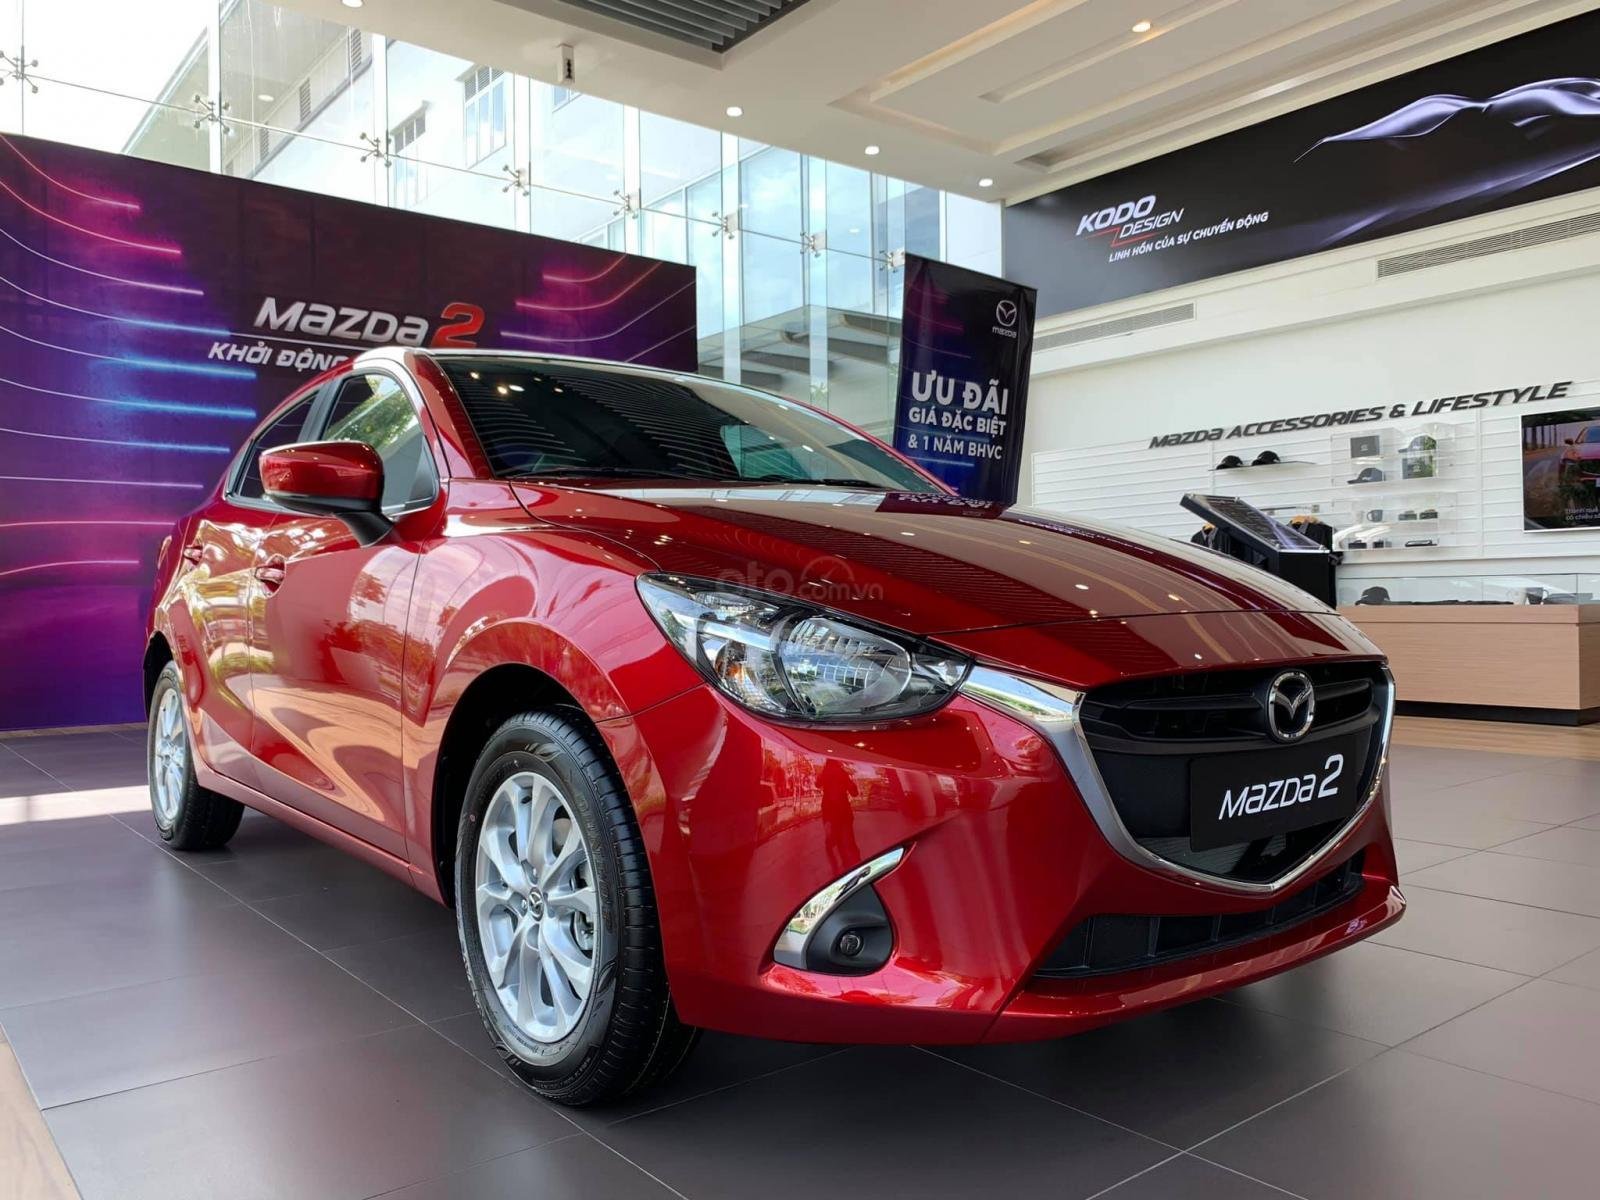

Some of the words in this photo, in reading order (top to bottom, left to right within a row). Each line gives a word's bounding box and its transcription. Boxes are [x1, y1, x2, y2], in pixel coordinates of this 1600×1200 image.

[1075, 194, 1157, 236] KODO
[1119, 207, 1185, 239] DESIGN
[1108, 248, 1131, 263] LINH
[1154, 234, 1175, 251] CỦA
[1176, 230, 1193, 246] SỰ
[1235, 211, 1270, 232] ĐỘNG
[991, 326, 1017, 339] mazda
[207, 341, 271, 365] KHỞI
[911, 370, 955, 406] ƯU
[962, 379, 1009, 415] ĐÃI
[908, 405, 938, 426] GIÁ
[941, 409, 973, 433] ĐẶC
[976, 415, 1007, 438] BIỆT
[1226, 405, 1386, 440] ACCESSORIES
[1388, 403, 1406, 419] &
[1411, 381, 1573, 417] LIFESTYLE
[907, 434, 918, 449] &
[923, 436, 929, 450] 1
[933, 433, 964, 455] NĂM
[967, 442, 1003, 460] BHVC
